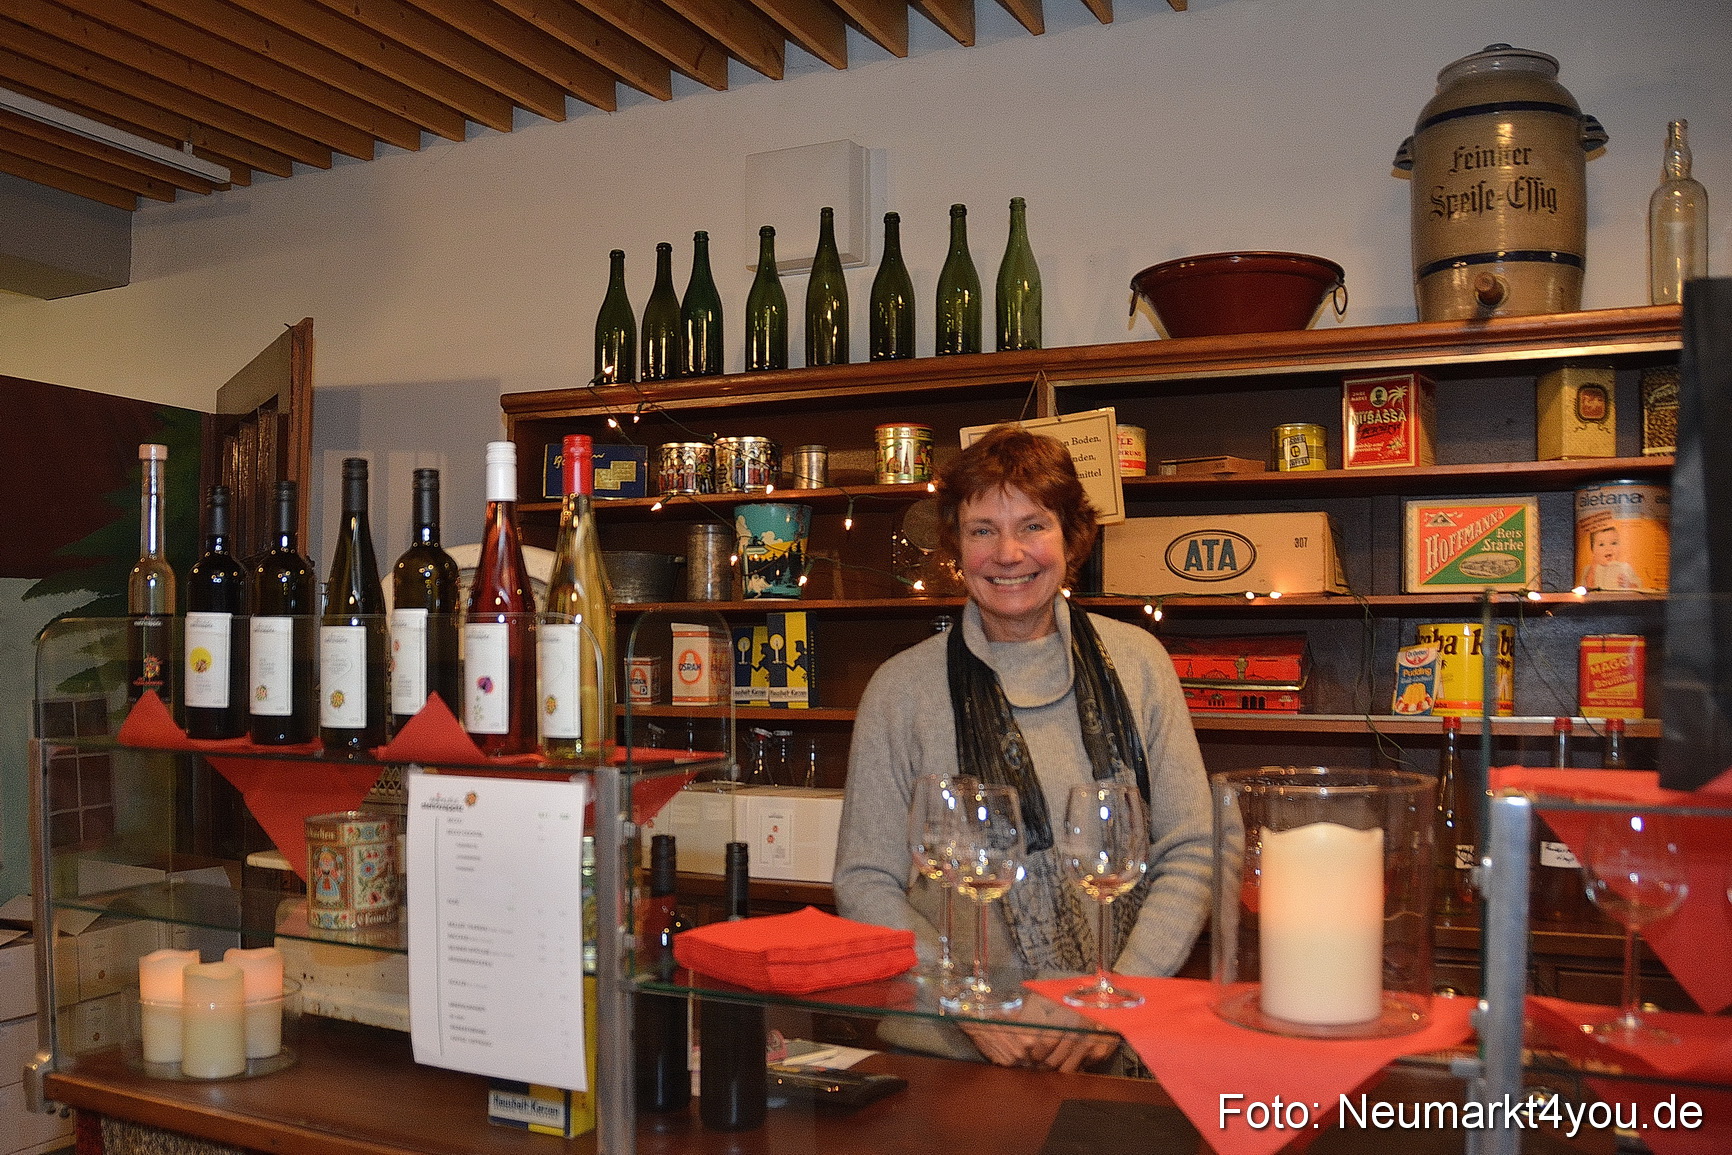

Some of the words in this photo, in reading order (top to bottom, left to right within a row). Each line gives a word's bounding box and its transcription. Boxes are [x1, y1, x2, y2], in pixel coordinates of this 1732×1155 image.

[1449, 145, 1532, 174] Feiner
[1071, 435, 1102, 446] Boden,
[1496, 527, 1523, 539] Reis
[1294, 536, 1309, 549] 307
[1424, 507, 1506, 575] HOFFMANN'S
[1481, 537, 1524, 552] Stärke
[1183, 538, 1238, 572] ATA
